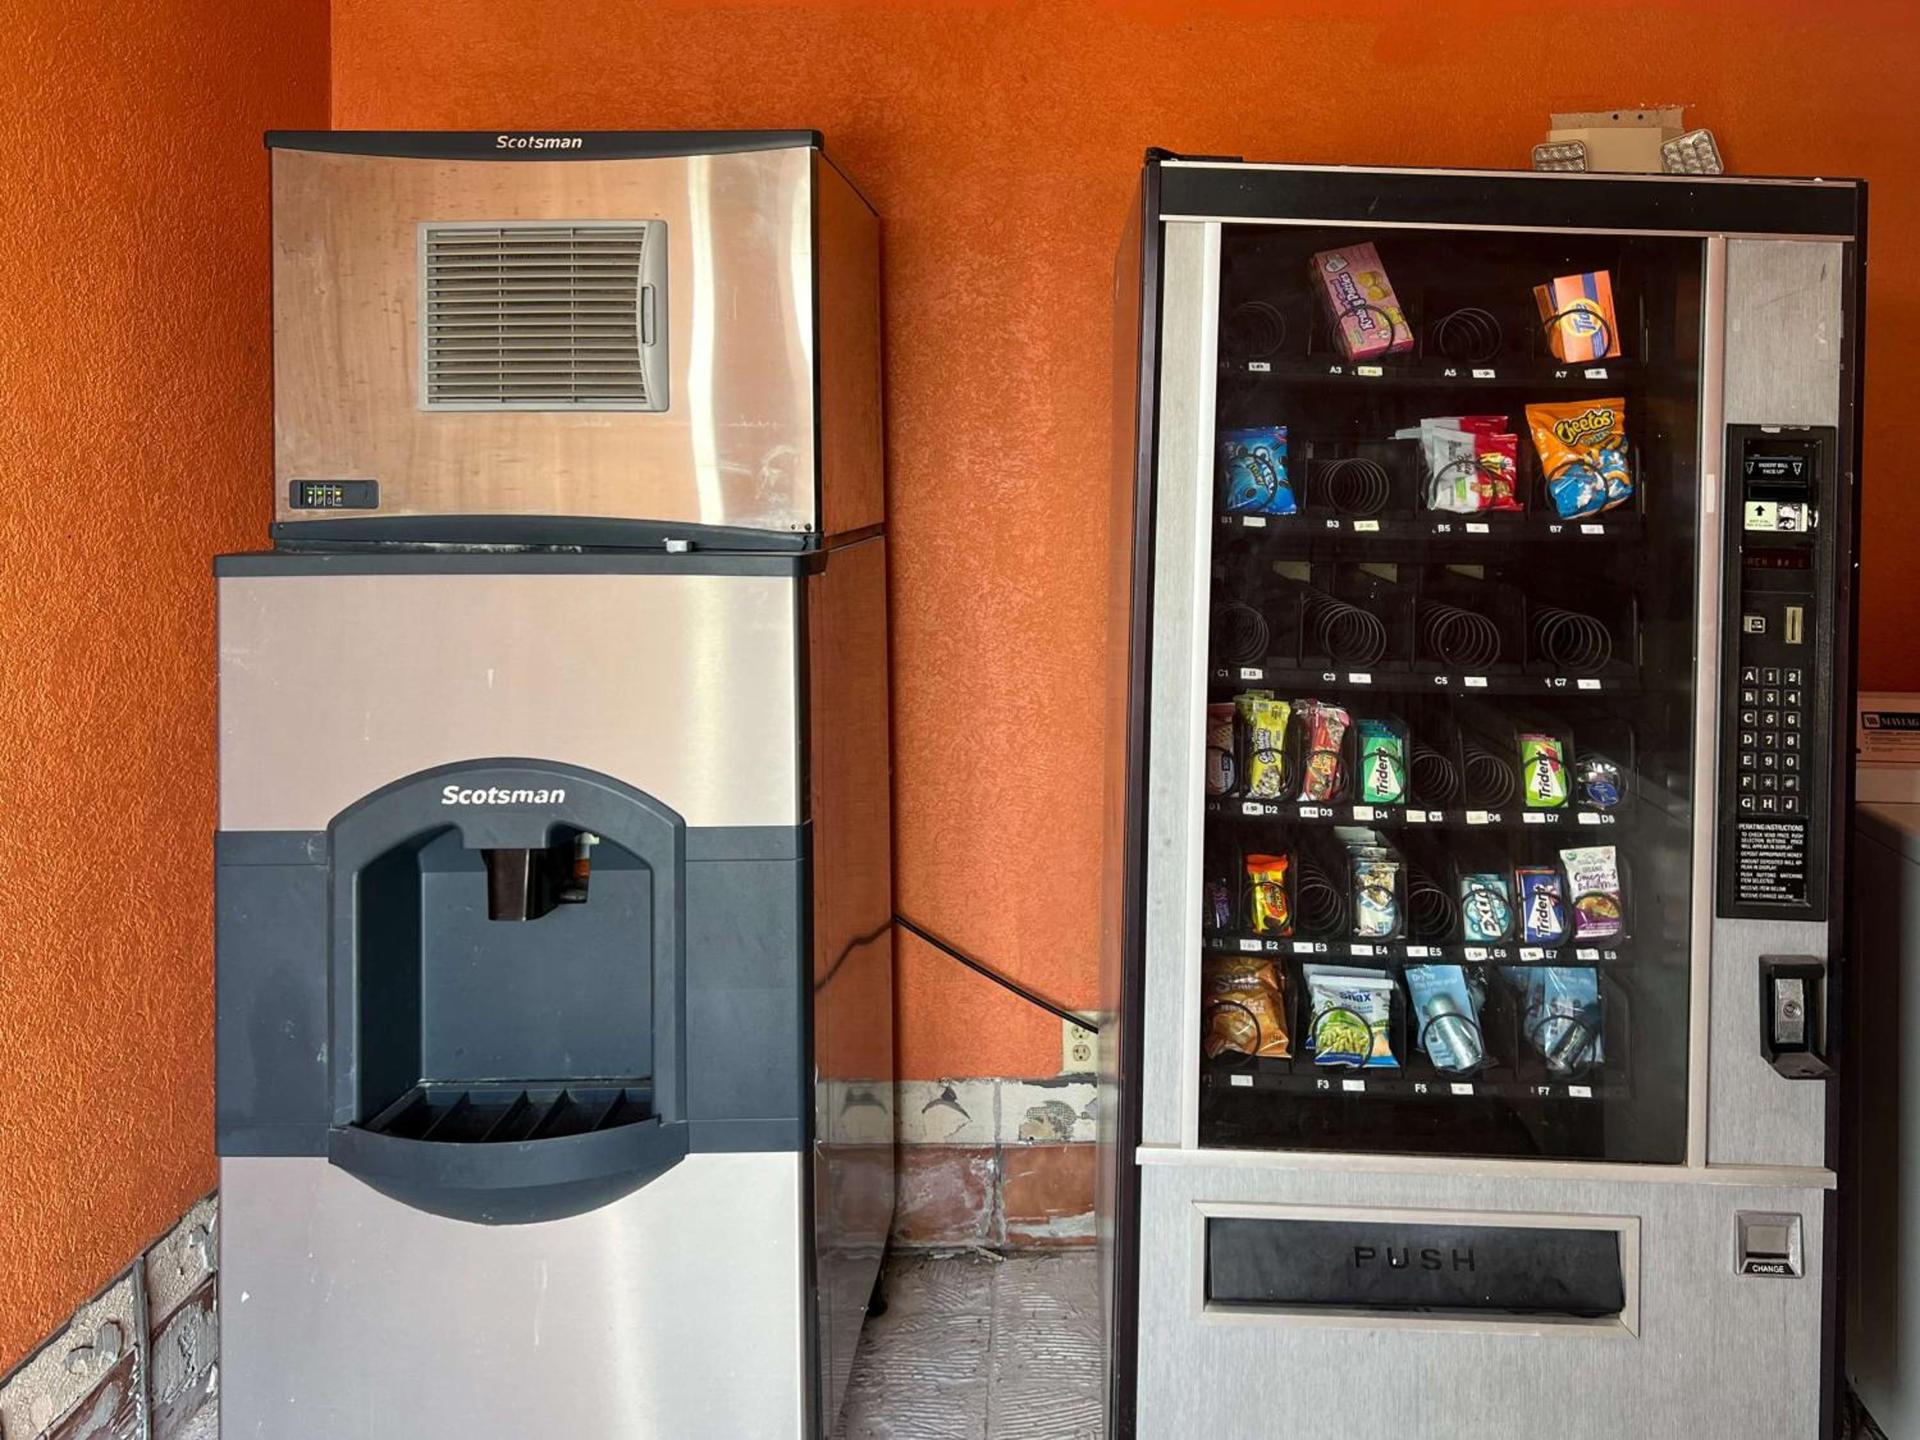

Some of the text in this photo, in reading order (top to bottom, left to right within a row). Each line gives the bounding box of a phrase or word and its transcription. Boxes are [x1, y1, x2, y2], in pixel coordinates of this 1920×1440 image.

[496, 135, 582, 148] Scotsman
[1353, 299, 1374, 330] Kraby
[1329, 365, 1342, 374] A3
[1444, 368, 1457, 377] A5
[1555, 371, 1567, 379] A7
[1556, 410, 1612, 444] Cheetos
[1326, 520, 1340, 528] B3
[1438, 524, 1450, 532] B5
[1322, 672, 1336, 682] C3
[1745, 671, 1754, 680] A
[1768, 672, 1773, 681] 1
[1788, 672, 1796, 682] 2
[1434, 676, 1448, 685] C5
[1554, 678, 1567, 686] C7
[1745, 692, 1753, 702] B
[1766, 693, 1774, 702] 3
[1788, 694, 1795, 703] 4
[1744, 713, 1753, 723] C
[1766, 714, 1774, 724] 5
[1787, 715, 1795, 724] 6
[1744, 734, 1753, 744] D
[1766, 736, 1773, 744] 7
[1787, 736, 1794, 746] 8
[1743, 756, 1752, 765] E
[1765, 756, 1772, 766] 9
[1786, 757, 1794, 766] 0
[1376, 746, 1389, 796] Trident
[1536, 750, 1552, 799] Trident
[1742, 777, 1751, 786] F
[441, 785, 566, 804] Scotsman
[1741, 798, 1751, 808] G
[1763, 799, 1772, 808] H
[1786, 800, 1793, 809] J
[1264, 805, 1278, 814] D2
[1320, 808, 1333, 817] D3
[1375, 810, 1388, 819] D4
[1488, 814, 1501, 822] D6
[1546, 814, 1559, 822] D7
[1601, 815, 1615, 823] D8
[1535, 885, 1549, 936] Trident
[1266, 940, 1278, 950] E2
[1315, 943, 1327, 952] E3
[1375, 946, 1388, 954] E4
[1429, 948, 1442, 956] E5
[1545, 950, 1558, 959] E7
[1604, 950, 1617, 960] E8
[1317, 1079, 1330, 1089] F3
[1415, 1083, 1427, 1093] F5
[1538, 1086, 1550, 1096] F7
[1354, 1246, 1475, 1272] PUSH
[1752, 1264, 1784, 1273] CHANGE
